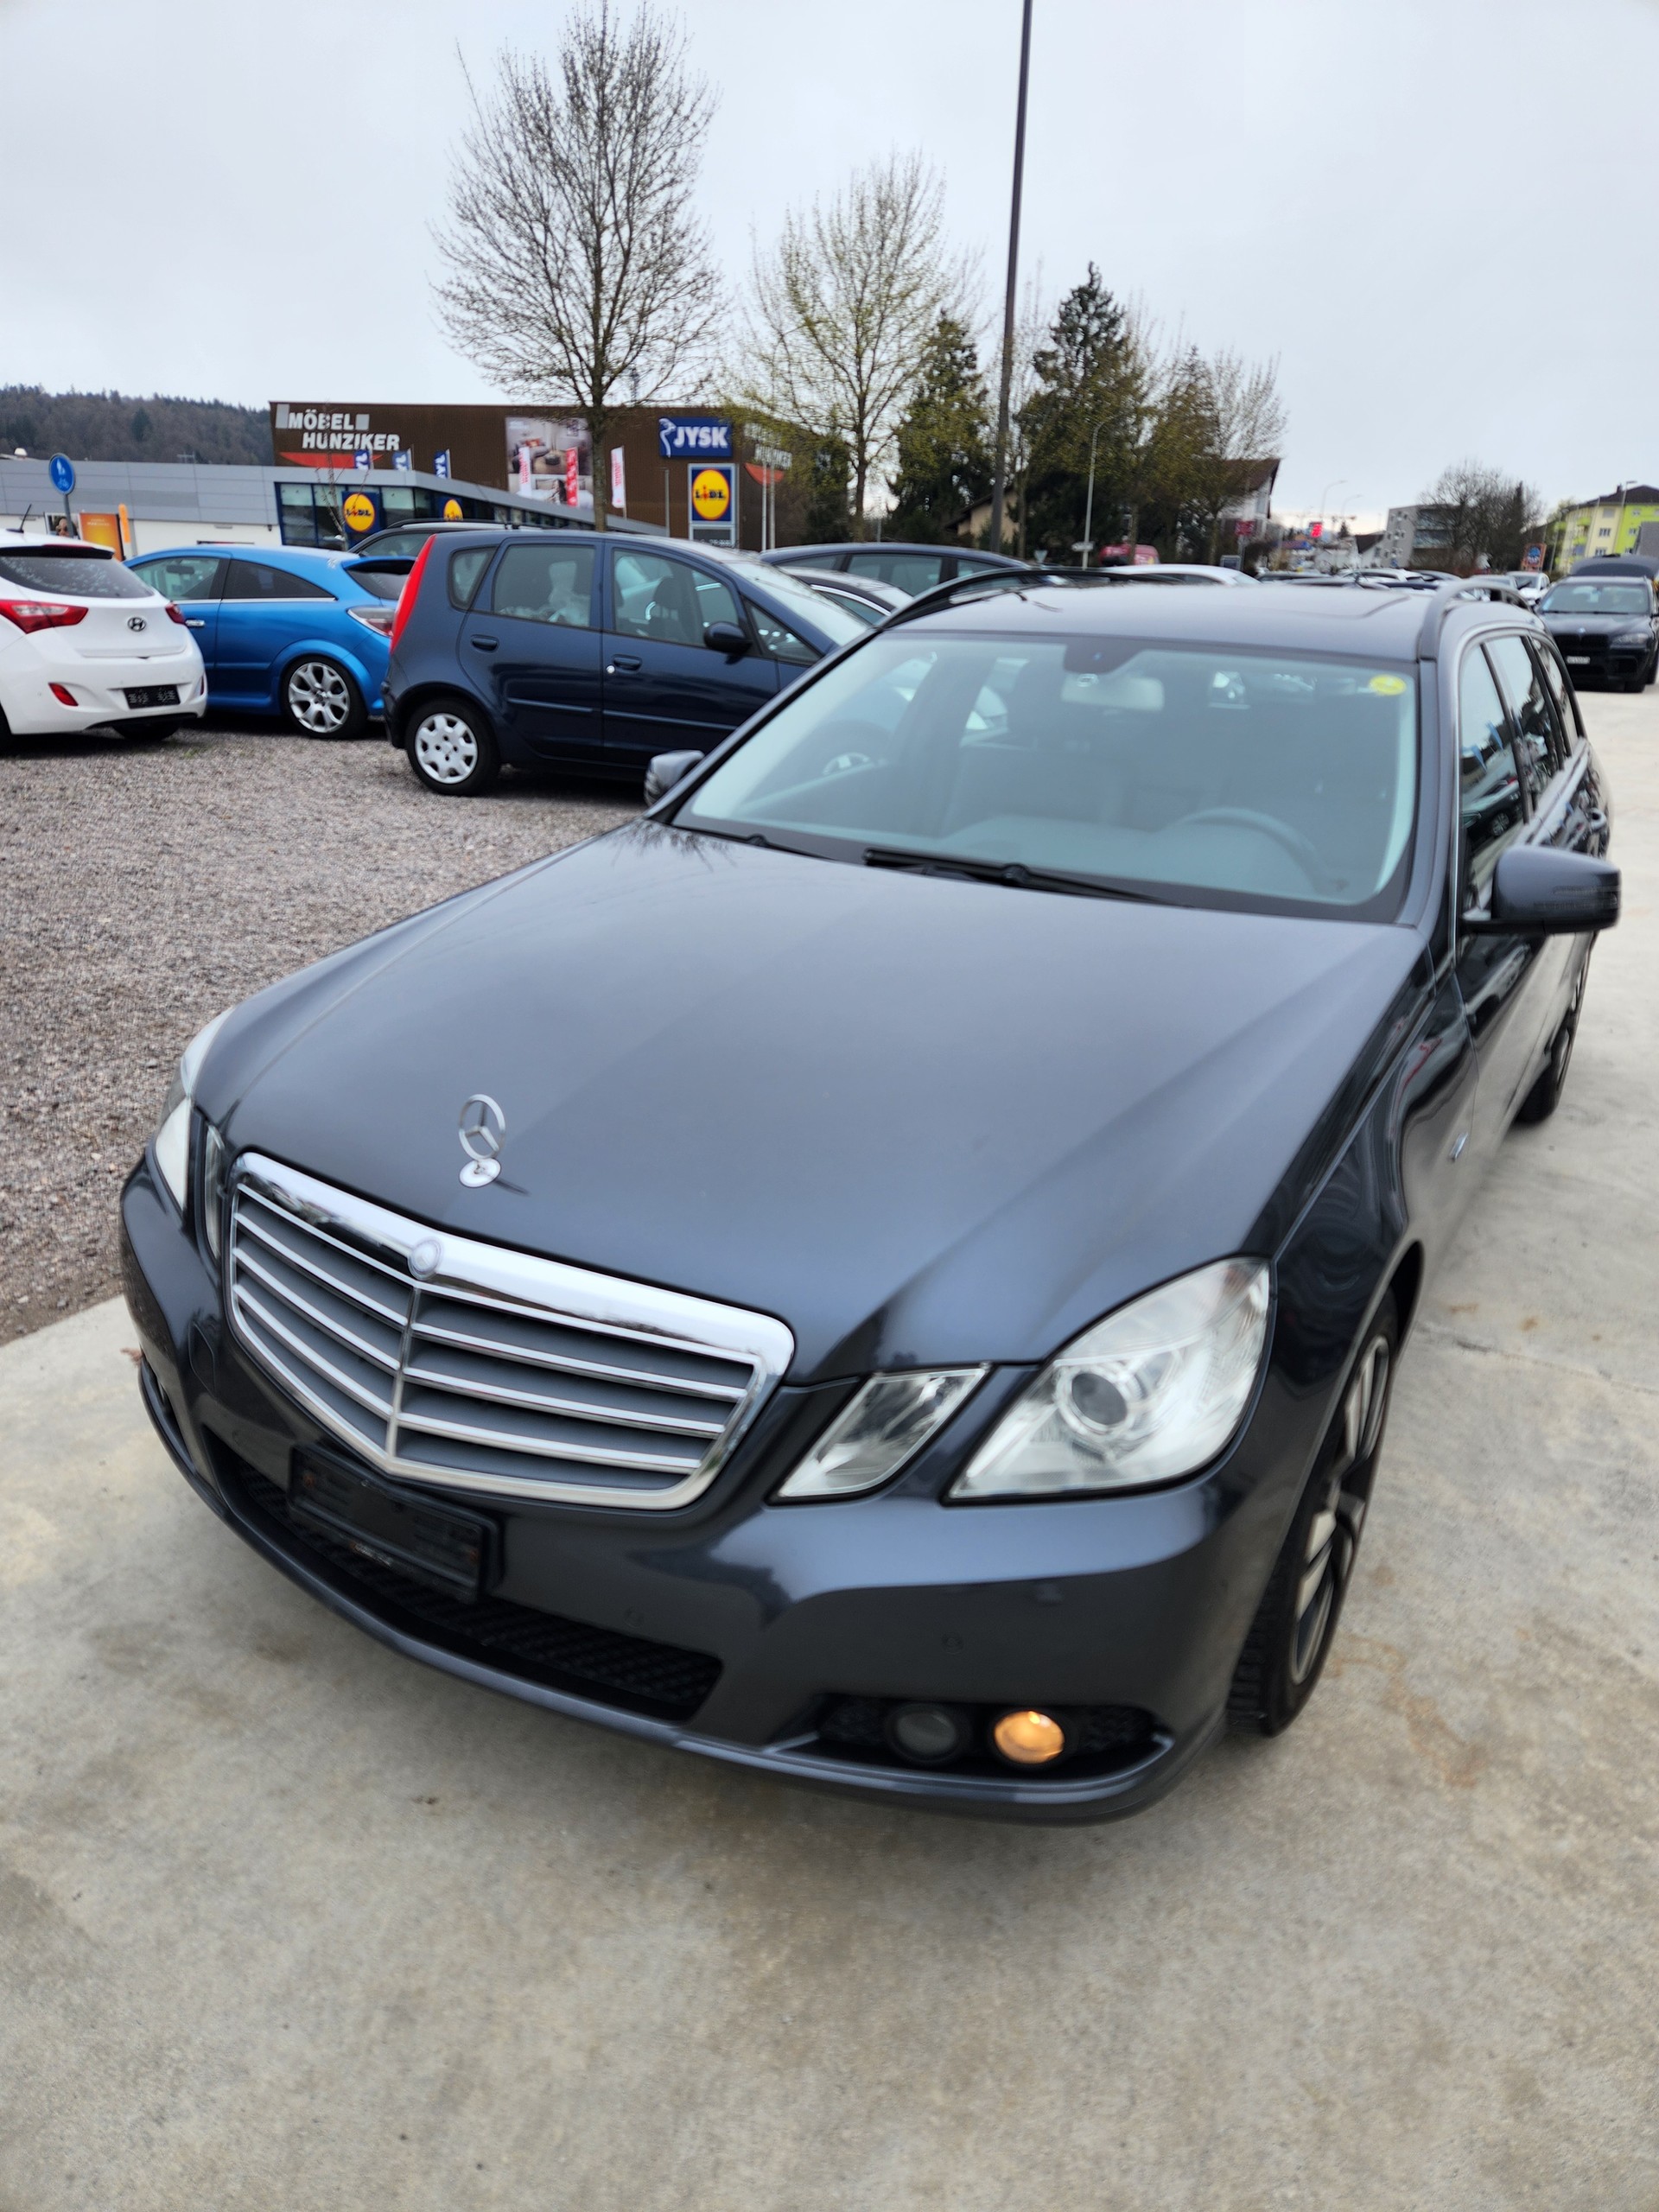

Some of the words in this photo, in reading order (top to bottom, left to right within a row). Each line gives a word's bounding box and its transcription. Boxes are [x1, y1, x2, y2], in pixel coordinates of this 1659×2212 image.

[289, 409, 354, 430] MÖBEL
[302, 432, 400, 450] HUNZIKER
[673, 426, 728, 448] JYSK
